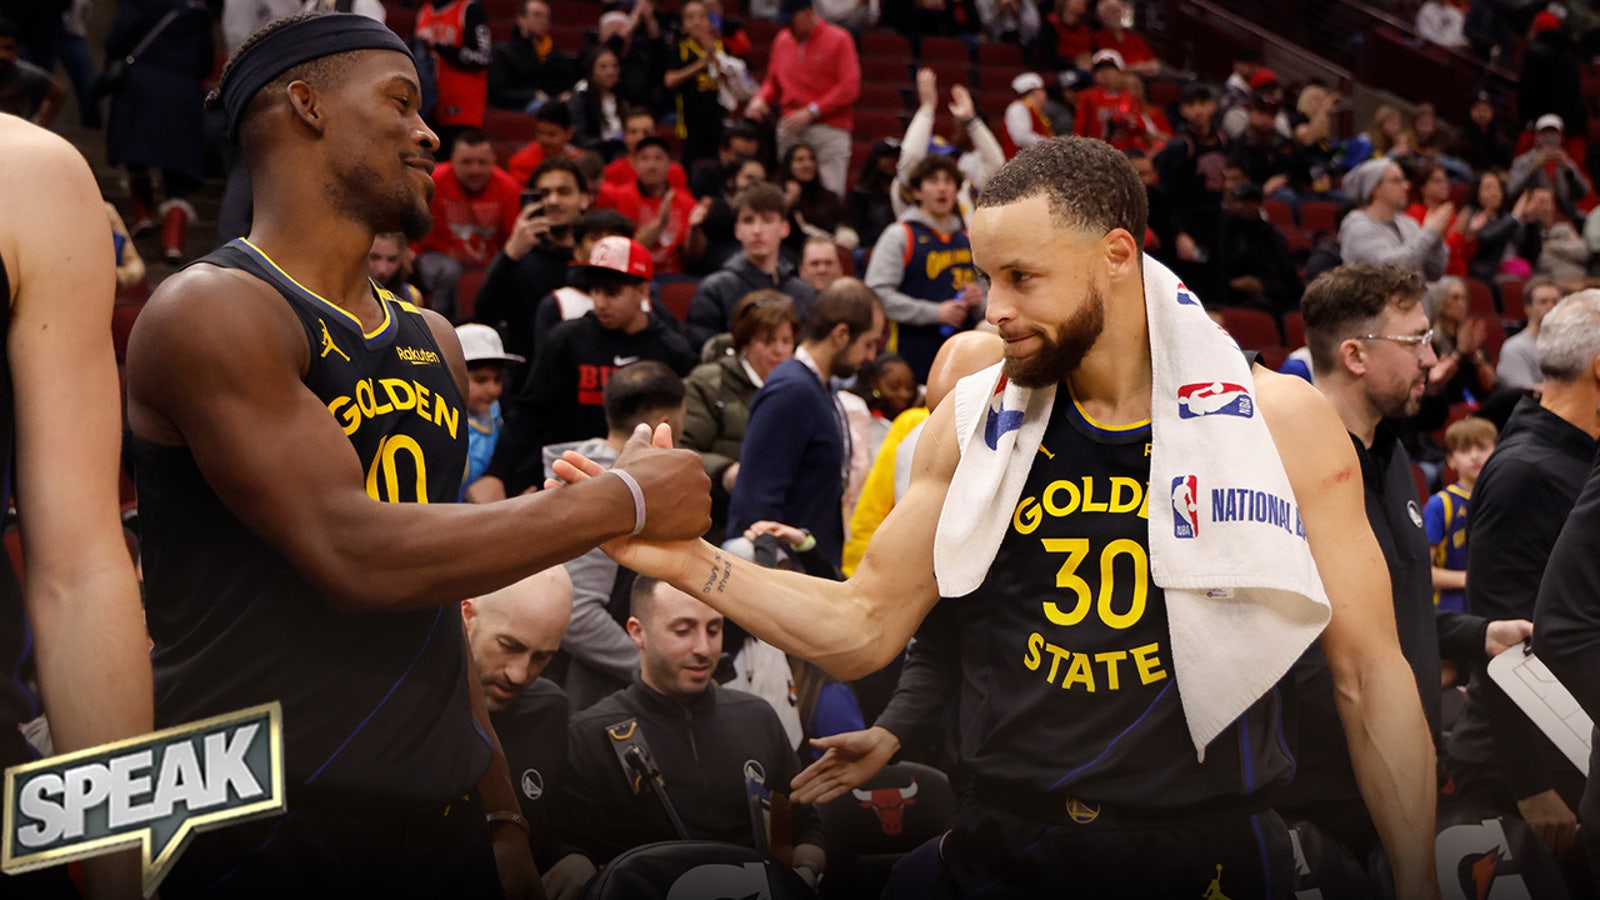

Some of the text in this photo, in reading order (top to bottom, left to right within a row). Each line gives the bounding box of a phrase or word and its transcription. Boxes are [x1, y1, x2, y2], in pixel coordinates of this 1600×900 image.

[395, 345, 440, 364] Rakuten
[328, 378, 459, 440] GOLDEN
[1239, 397, 1251, 415] NBA
[1176, 525, 1191, 536] NBA
[1212, 488, 1292, 534] NATIONAL
[1040, 538, 1148, 629] 30
[1024, 632, 1167, 692] STATE
